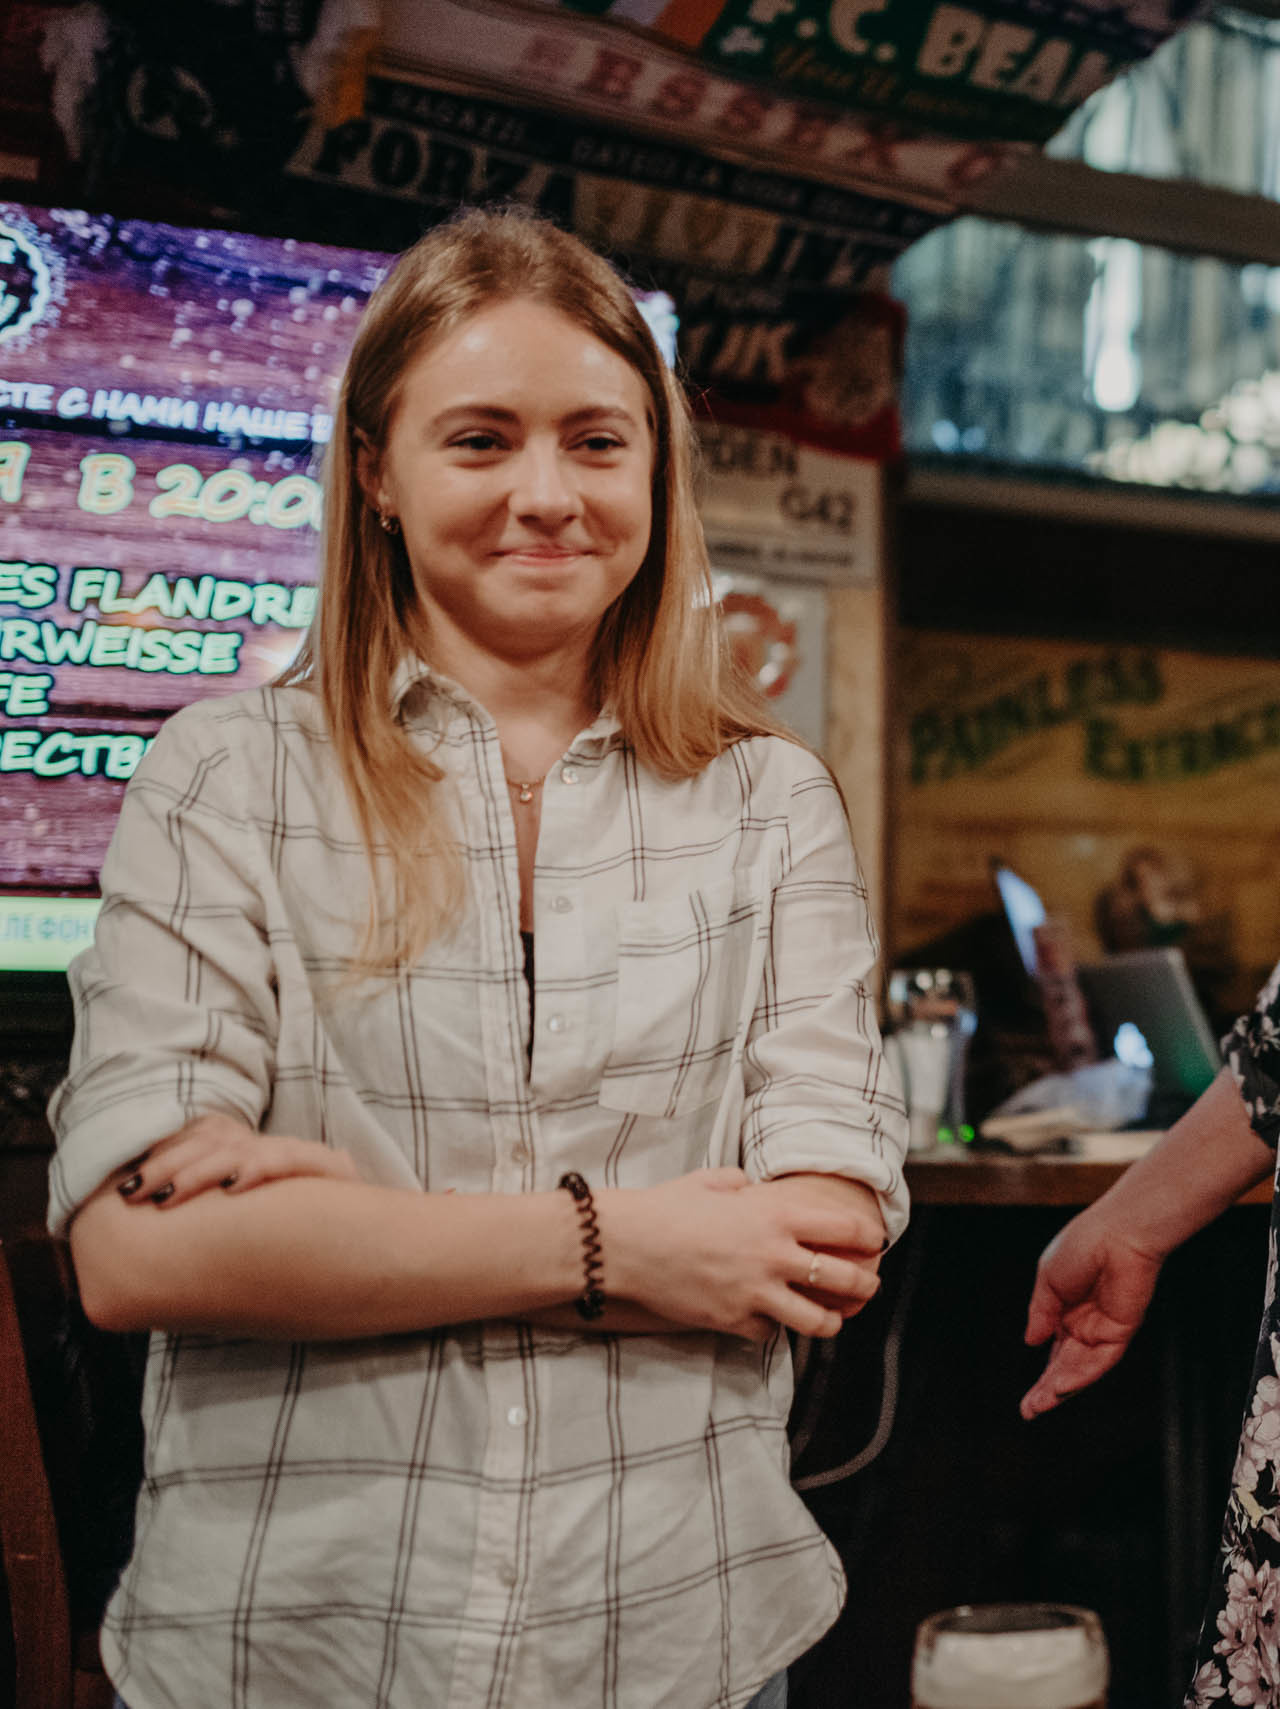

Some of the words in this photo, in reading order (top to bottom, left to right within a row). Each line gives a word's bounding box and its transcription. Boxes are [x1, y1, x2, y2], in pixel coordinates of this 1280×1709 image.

[56, 386, 91, 420] С
[91, 389, 198, 430] НАМИ
[202, 401, 310, 439] НАШЕ
[149, 463, 322, 530] 20:0
